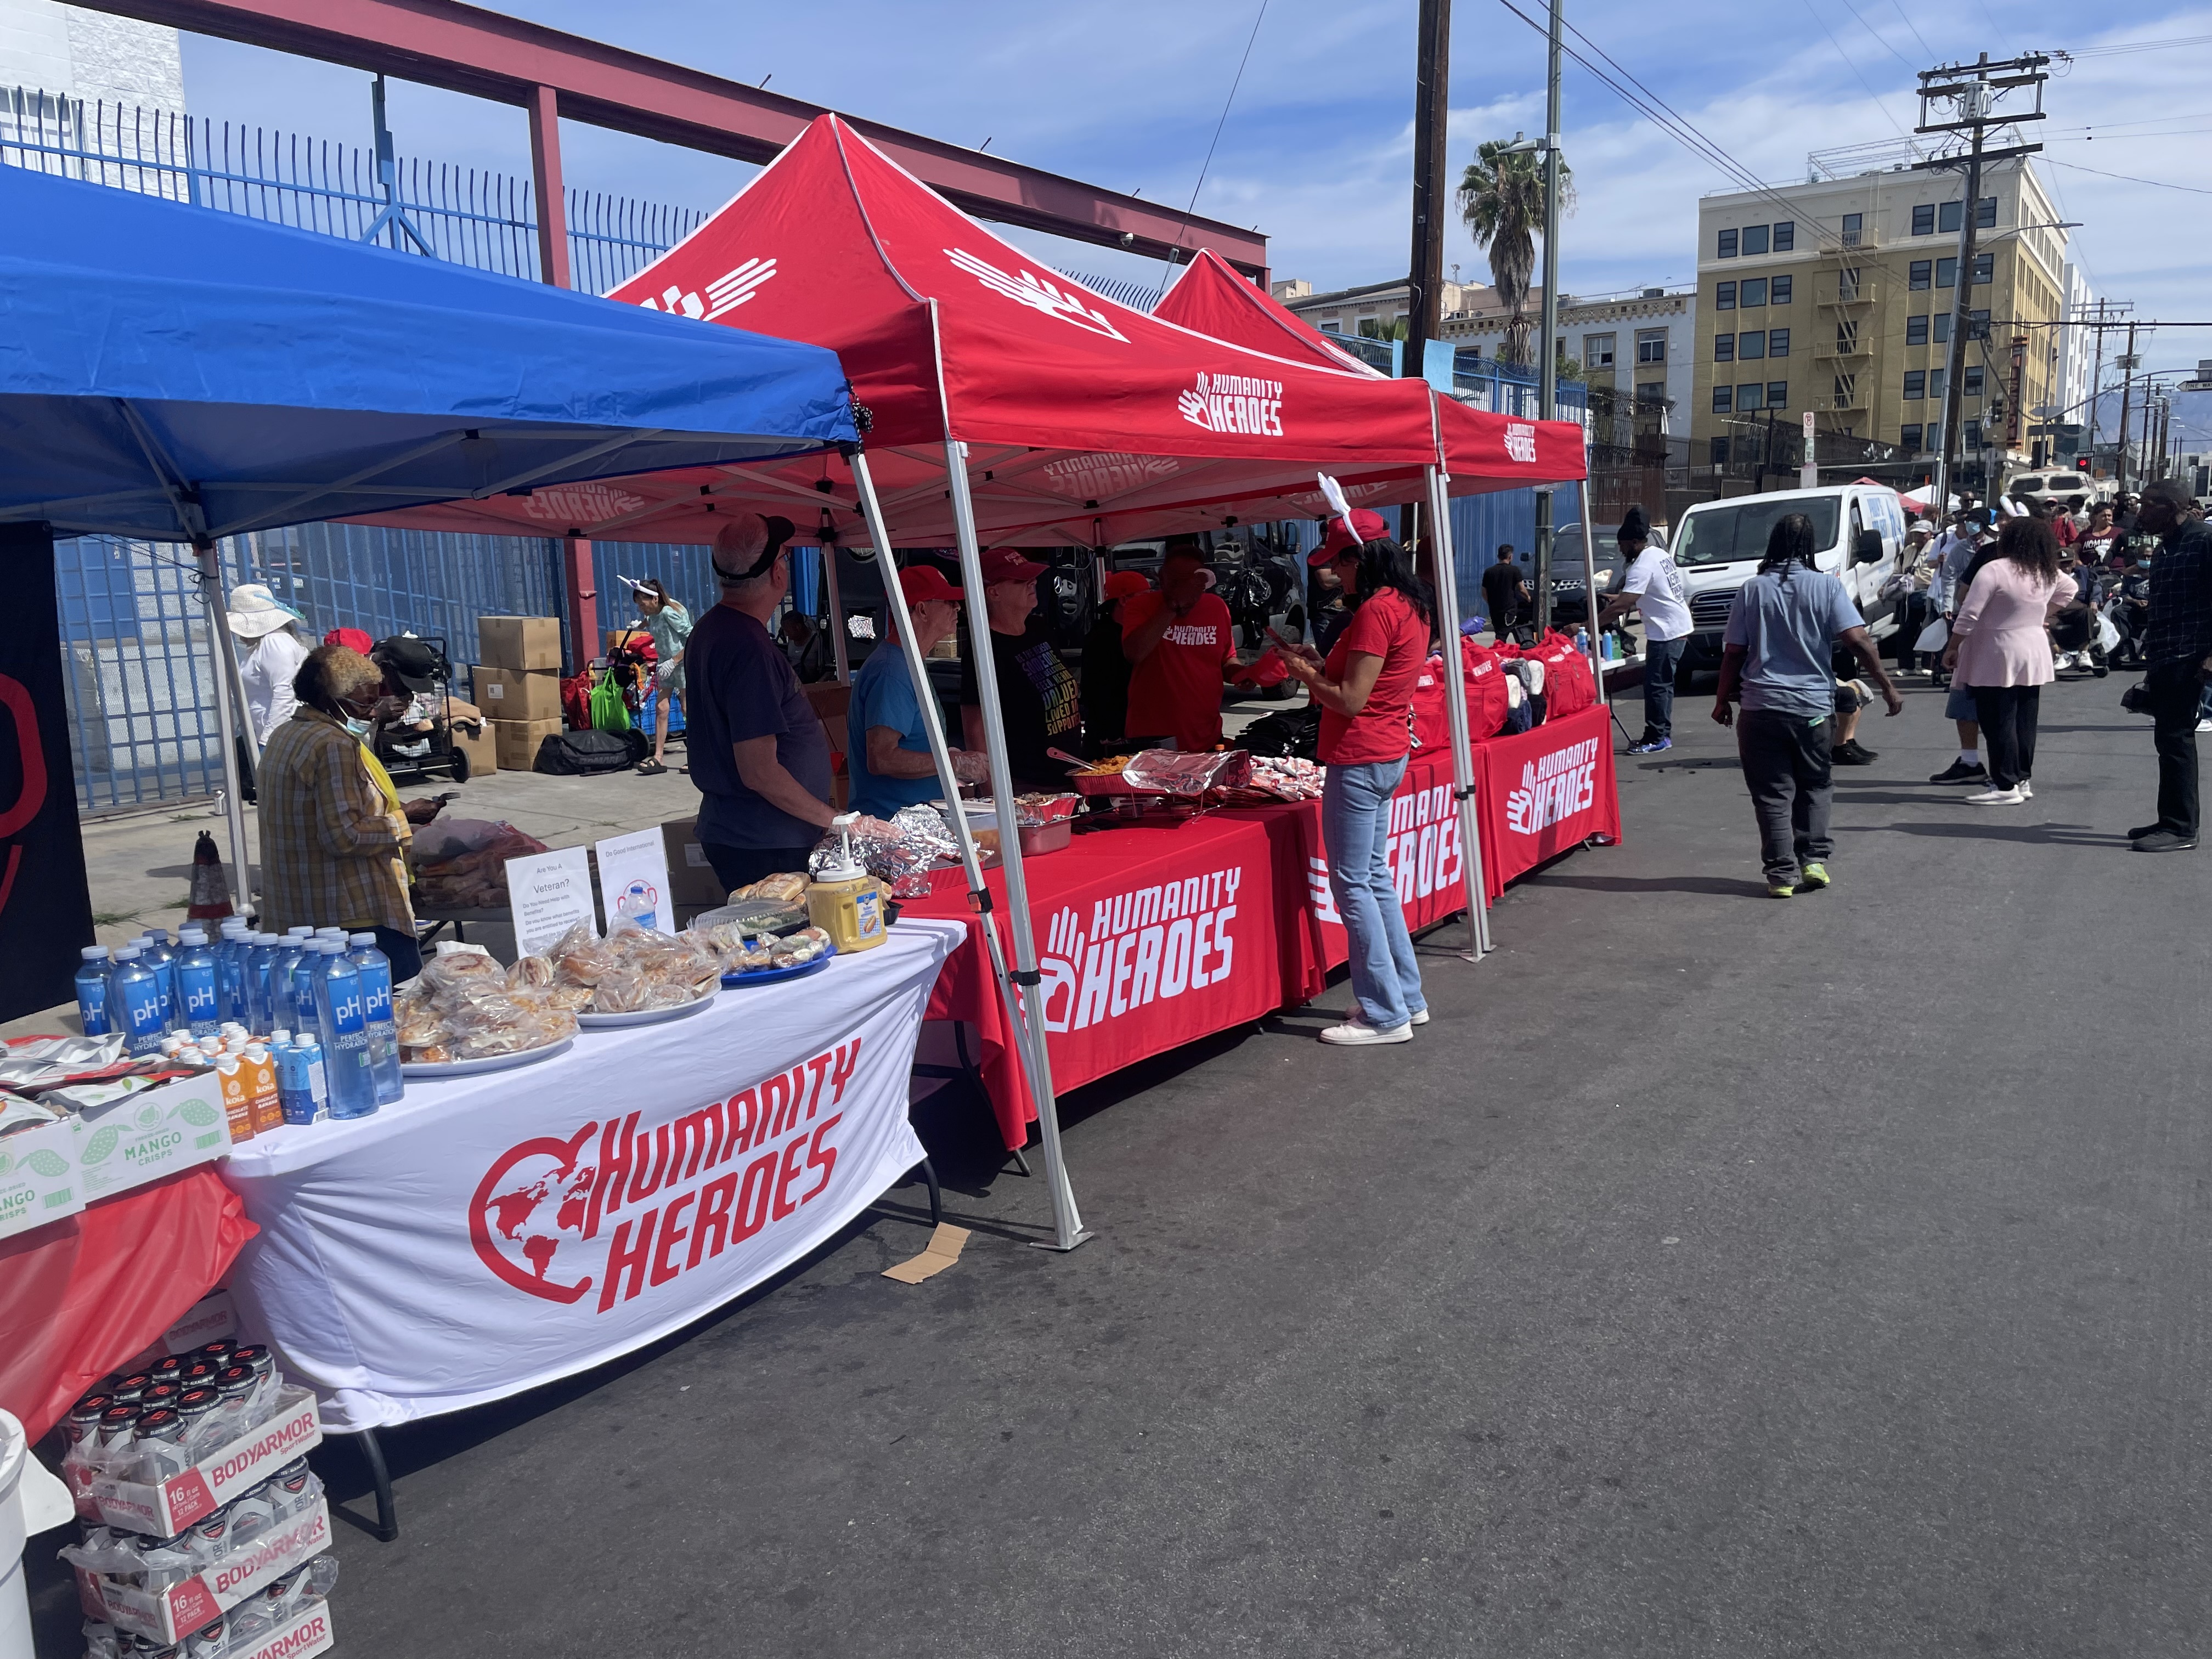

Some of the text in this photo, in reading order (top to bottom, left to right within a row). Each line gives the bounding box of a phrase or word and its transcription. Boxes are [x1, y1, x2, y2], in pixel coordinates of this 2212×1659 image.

[1212, 373, 1283, 399] HUMANITY
[1209, 394, 1284, 437] HEROES
[1513, 436, 1536, 462] HEROES
[1172, 631, 1216, 646] HEROES
[1174, 625, 1217, 633] HUMANITY
[1538, 737, 1599, 776] HUMANITY
[1532, 761, 1595, 834] HEROES
[613, 847, 627, 855] Good
[627, 840, 655, 852] International
[1385, 817, 1464, 907] EROES
[533, 878, 570, 893] Veteran?
[1090, 867, 1242, 943] HUMANITY
[1074, 904, 1238, 1031] HEROES
[188, 986, 215, 1013] pH
[366, 985, 390, 1014] pH
[82, 1001, 106, 1026] pH
[133, 997, 159, 1027] pH
[336, 995, 362, 1025] pH
[191, 1020, 217, 1029] PERFECT
[369, 1021, 392, 1030] PERFECT
[138, 1031, 163, 1043] PERFECT
[340, 1031, 364, 1042] PERFECT
[256, 1082, 275, 1094] koia
[225, 1094, 246, 1105] koia
[255, 1093, 278, 1104] CHOCOLATE
[258, 1099, 278, 1109] BANANA
[135, 1127, 170, 1142] FREEZE-DRIED
[582, 1037, 862, 1240] HUMANITY
[124, 1132, 182, 1160] MANGO
[138, 1149, 173, 1166] CRISPS
[0, 1189, 35, 1211] NGO
[0, 1207, 27, 1221] RISPS
[597, 1111, 843, 1314] HEROES
[211, 1412, 315, 1488] BODYARMOR
[280, 1430, 315, 1455] SportWater
[170, 1487, 184, 1505] 16
[177, 1508, 184, 1516] 12
[184, 1500, 199, 1513] PACK
[173, 1594, 187, 1612] 16
[187, 1606, 201, 1618] PACK
